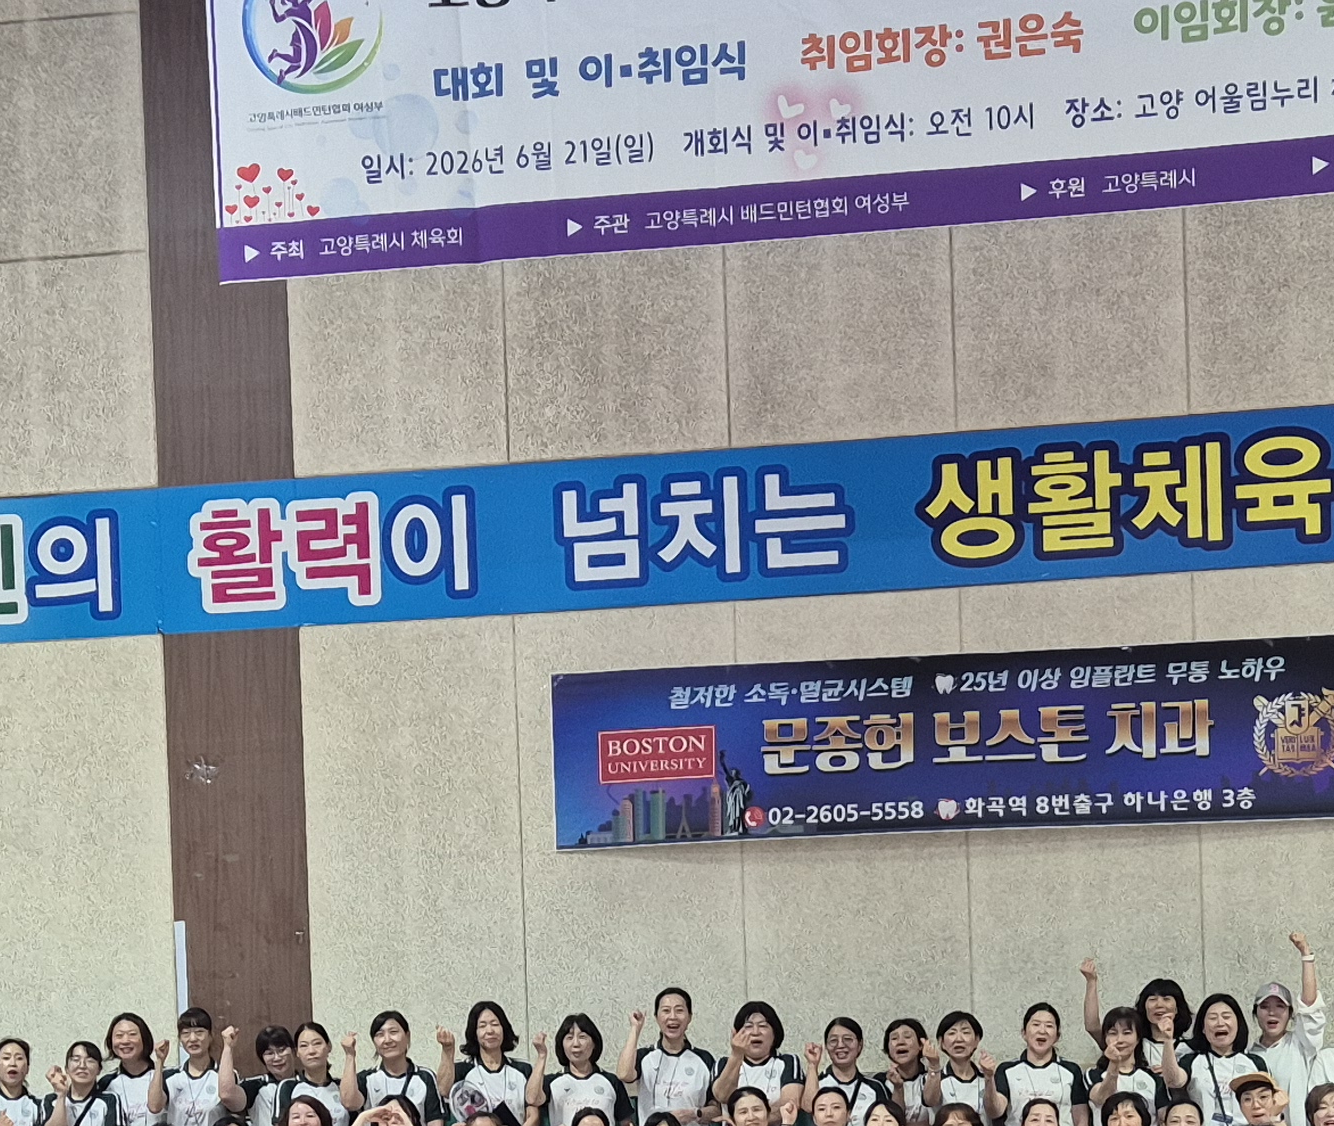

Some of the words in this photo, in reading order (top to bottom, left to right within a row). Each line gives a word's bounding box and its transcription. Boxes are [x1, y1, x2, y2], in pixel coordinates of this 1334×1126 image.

[800, 25, 965, 70] 취임회장:
[976, 11, 1086, 61] 권은숙
[1133, 0, 1305, 43] 이임회장:
[433, 62, 504, 101] 대회
[525, 57, 560, 99] 및
[1064, 95, 1123, 126] 장소:
[1134, 88, 1185, 120] 고양
[1194, 76, 1318, 114] 어울림누리
[682, 126, 754, 158] 개회식
[764, 122, 786, 153] 및
[926, 106, 973, 138] 오전
[984, 101, 1035, 132] 10시
[360, 152, 415, 185] 일시:
[425, 141, 506, 178] 2026년
[514, 141, 554, 171] 6월
[564, 132, 655, 167] 21일(일)
[1048, 176, 1087, 201] 후원
[1101, 165, 1197, 195] 고양특례시
[593, 212, 631, 237] 주관
[644, 205, 736, 233] 고양특례시
[739, 194, 850, 225] 배드민턴협회
[854, 190, 911, 217] 여성부
[269, 237, 305, 262] 주최
[318, 230, 407, 258] 고양특례시
[410, 226, 464, 253] 체육회
[191, 485, 476, 613] 활력이
[560, 470, 850, 586] 넘치는
[669, 684, 737, 709] 철저한
[960, 669, 1009, 695] 25년
[1017, 666, 1061, 691] 이상
[1069, 662, 1157, 689] 임플란트
[1165, 660, 1210, 685] 무통
[1218, 655, 1286, 682] 노하우
[607, 734, 707, 757] BOSTON
[760, 711, 915, 775] 문종현
[932, 705, 1089, 764] 보스톤
[1105, 698, 1215, 759] 치과
[607, 755, 708, 775] UNIVERSITY
[768, 801, 925, 827] 02-2605-5558
[964, 793, 1029, 819] 화곡역
[1035, 790, 1115, 816] 8번출구
[1123, 787, 1213, 813] 하나은행
[1222, 786, 1257, 809] 3층
